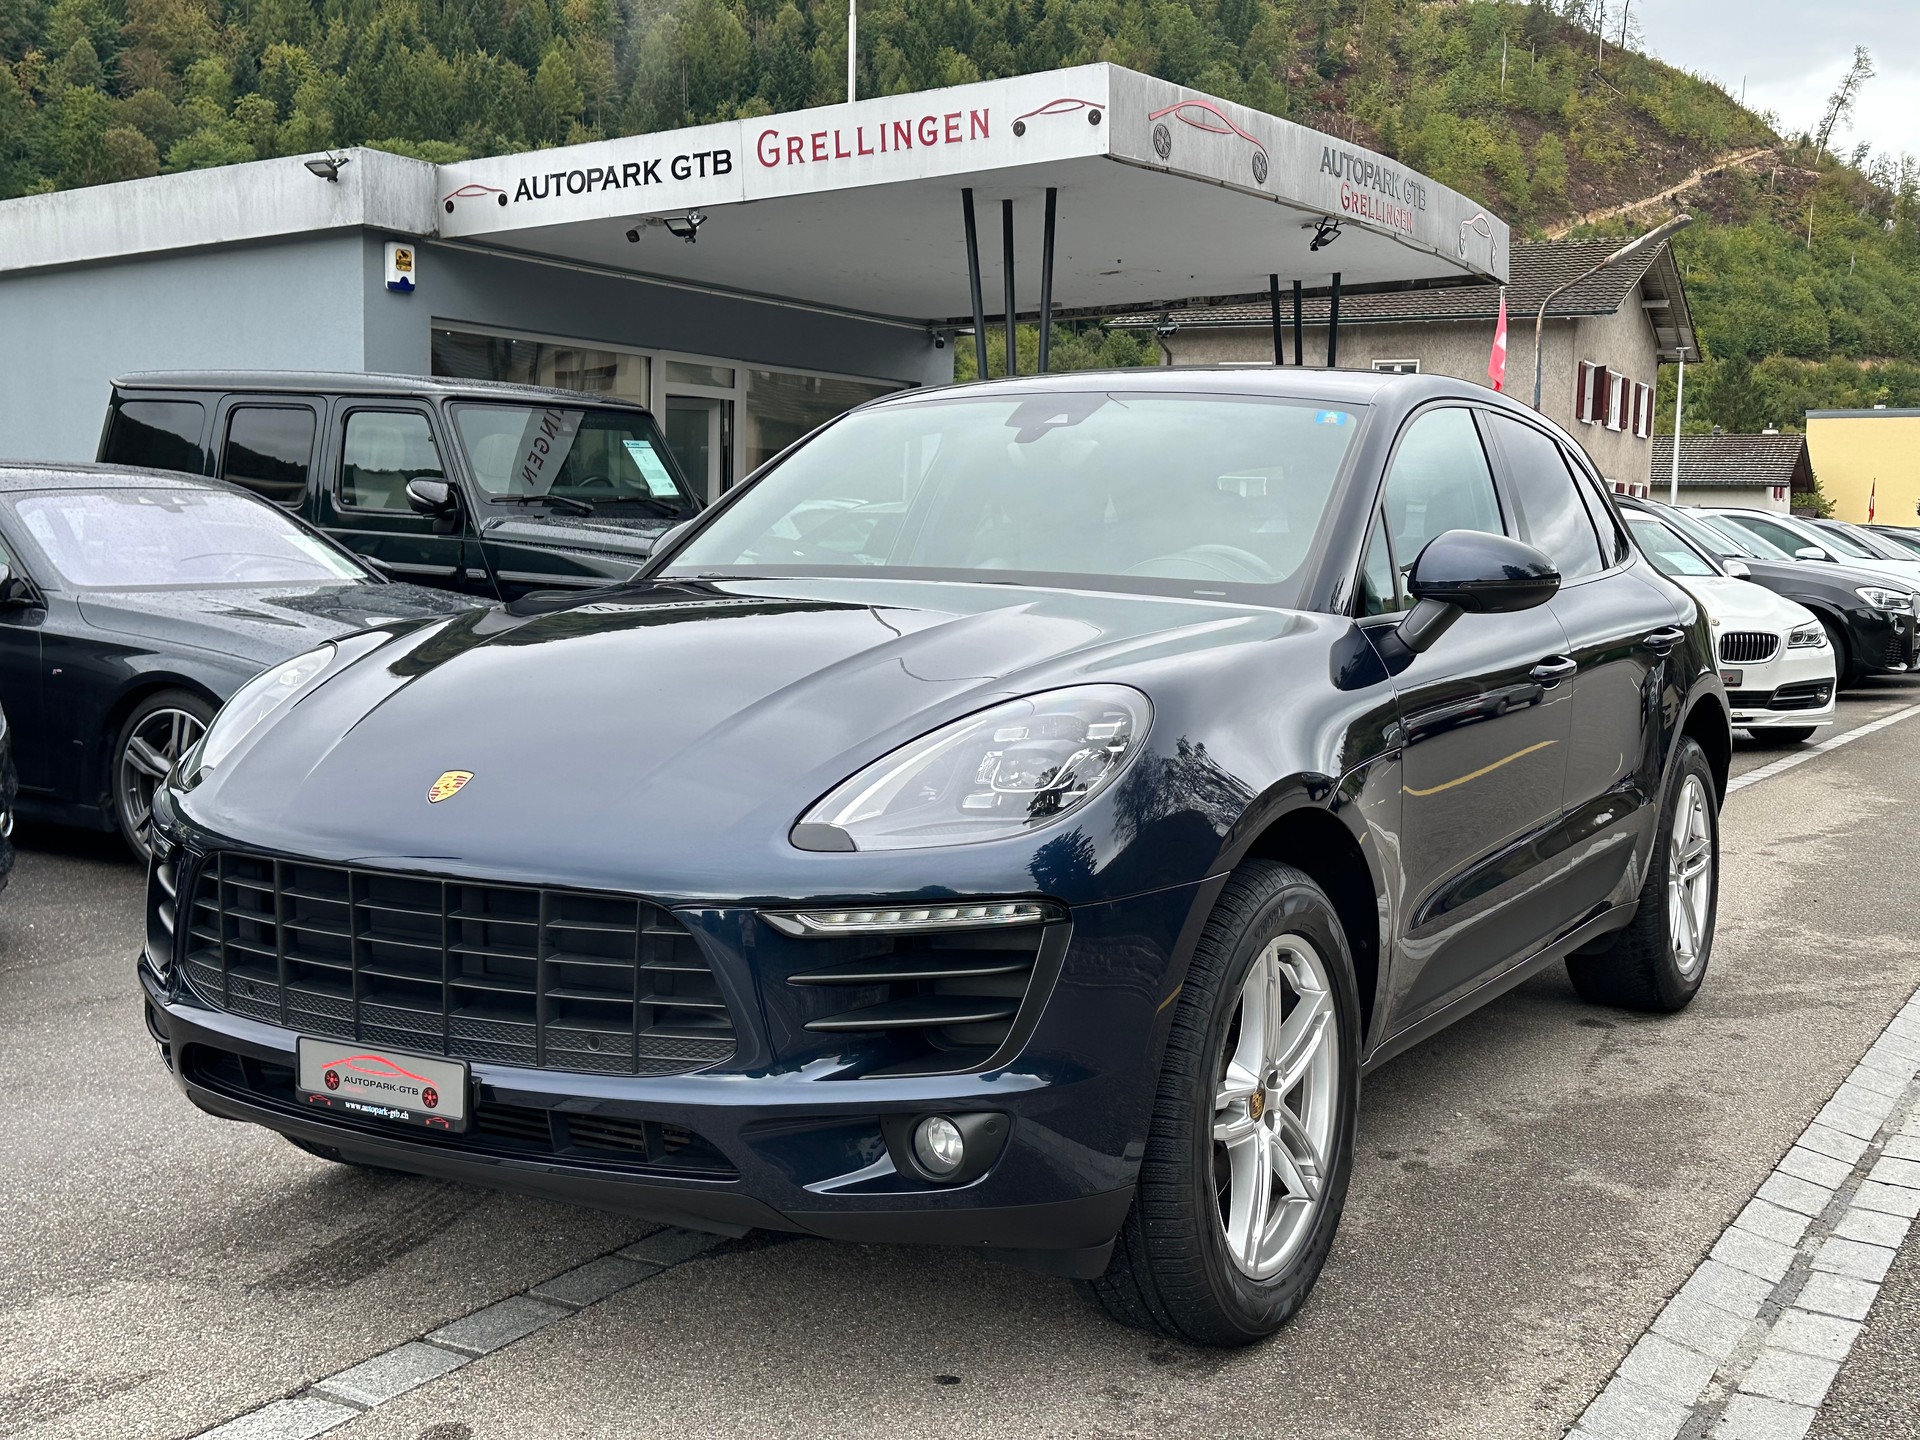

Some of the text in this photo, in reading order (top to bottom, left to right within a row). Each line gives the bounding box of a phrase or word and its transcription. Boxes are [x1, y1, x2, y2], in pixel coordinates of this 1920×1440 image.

[514, 108, 990, 203] AUTOPARK GTB GRELLINGEN
[1319, 146, 1428, 212] AUTOPARK GTB
[1340, 181, 1414, 235] GRELLINGEN
[345, 1101, 410, 1120] www.autopark-gtb.ch
